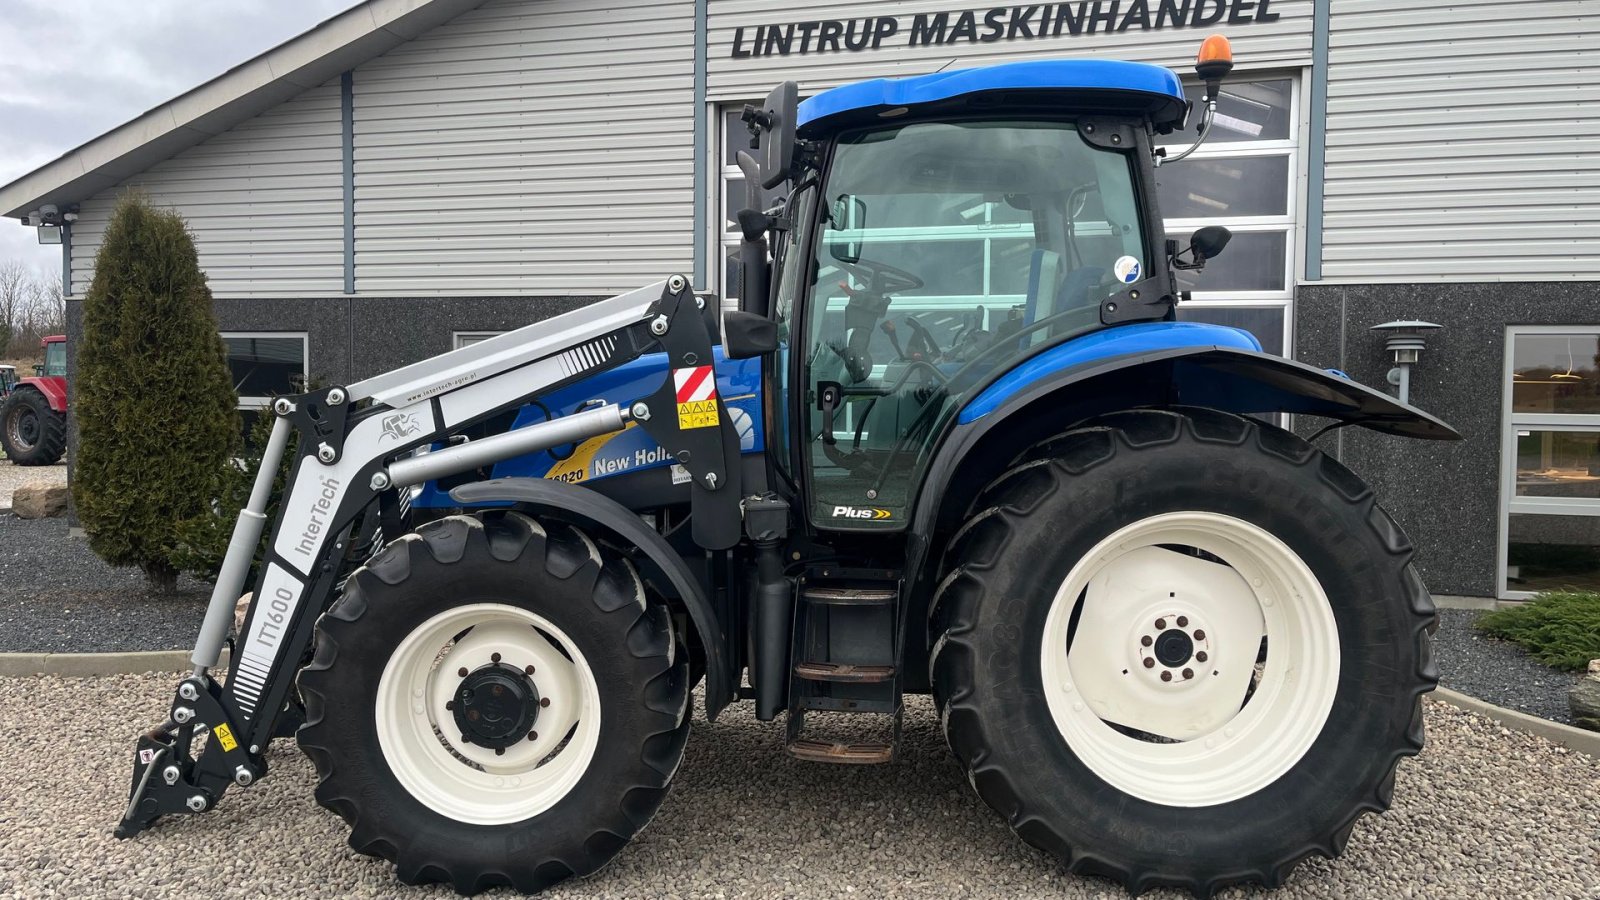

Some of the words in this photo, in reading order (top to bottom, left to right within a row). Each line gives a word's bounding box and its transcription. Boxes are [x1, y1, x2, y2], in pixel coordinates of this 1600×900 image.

[731, 16, 898, 58] LINTRUP
[908, 0, 1280, 46] MASKINHANDEL
[594, 456, 630, 476] New
[294, 478, 340, 556] InterTech
[832, 505, 873, 518] Plus
[256, 587, 293, 648] IT1600
